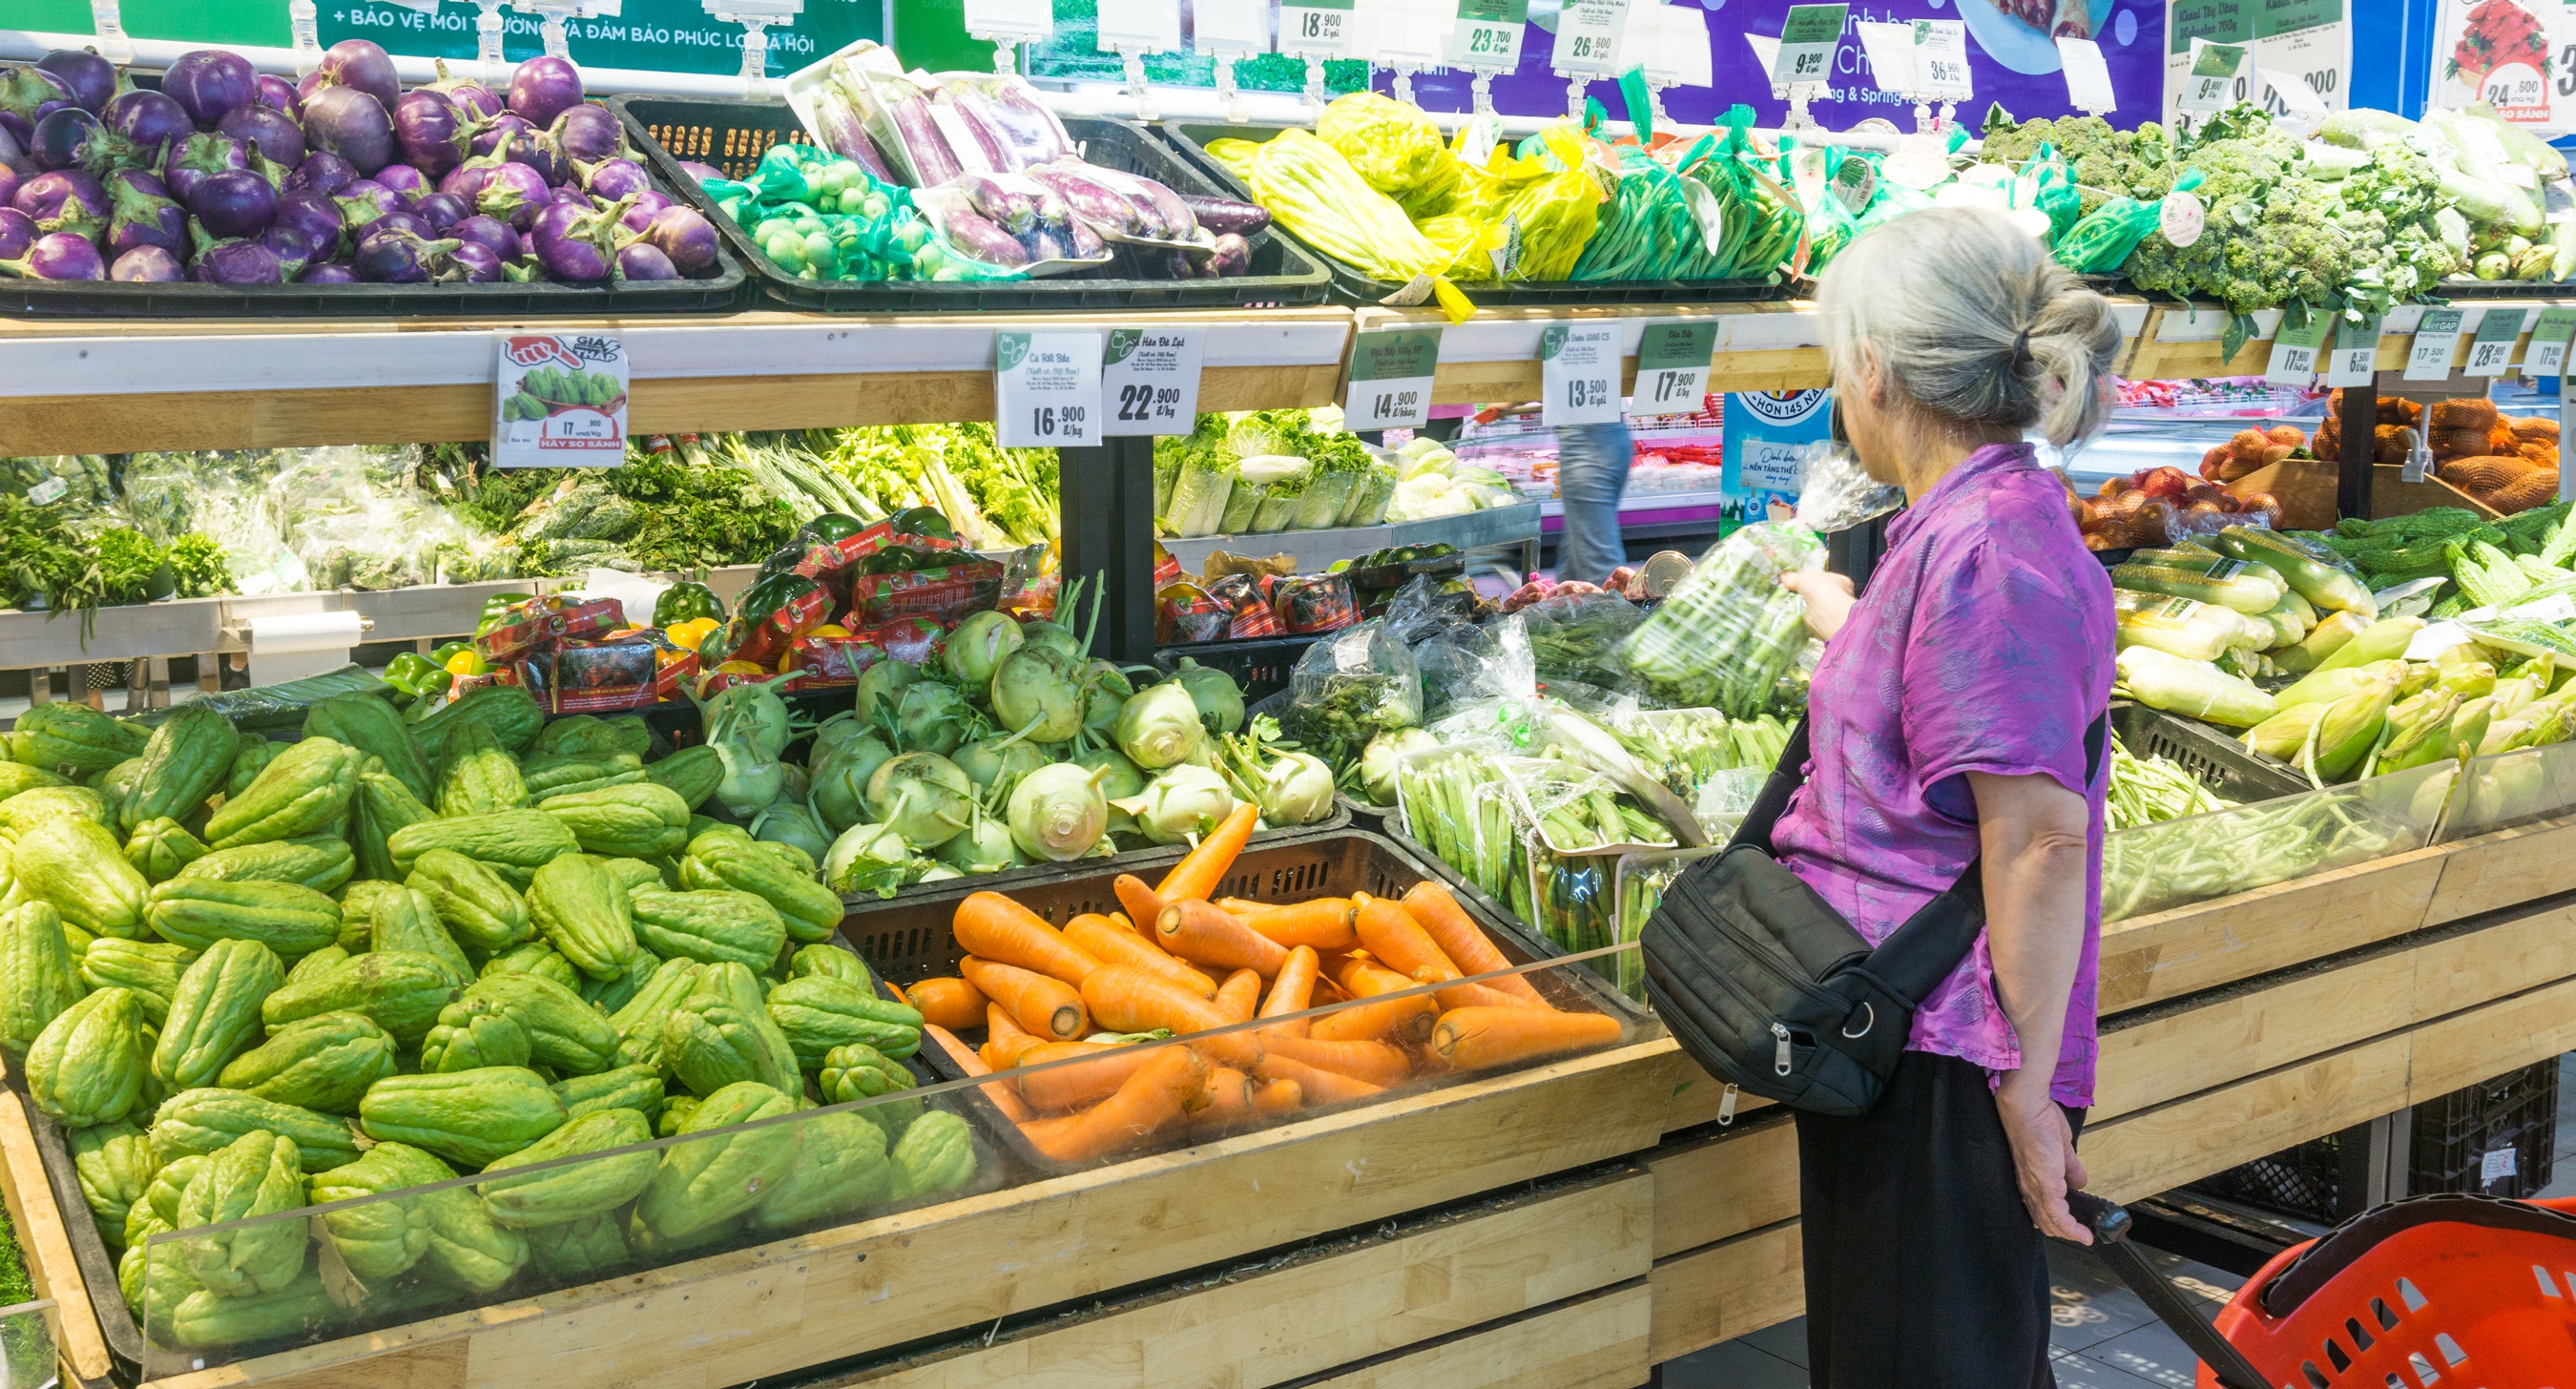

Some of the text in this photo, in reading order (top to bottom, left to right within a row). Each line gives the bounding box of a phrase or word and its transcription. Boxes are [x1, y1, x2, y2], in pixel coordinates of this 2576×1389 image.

[350, 6, 394, 27] BẢO
[399, 11, 426, 31] VỆ
[430, 10, 467, 31] MÔI
[586, 21, 626, 41] ĐẢM
[631, 23, 670, 43] BẢO
[675, 28, 720, 47] PHÚC
[785, 34, 814, 55] HỘI
[1848, 86, 1858, 101] &
[1860, 87, 1902, 107] Spring
[1568, 380, 1607, 408] 13.500
[1654, 371, 1695, 403] 17.900
[1118, 384, 1179, 421] 22.900
[1374, 391, 1418, 419] 14.900
[1785, 402, 1802, 415] 145
[1033, 406, 1085, 436] 16.900
[588, 439, 619, 447] SÁNH
